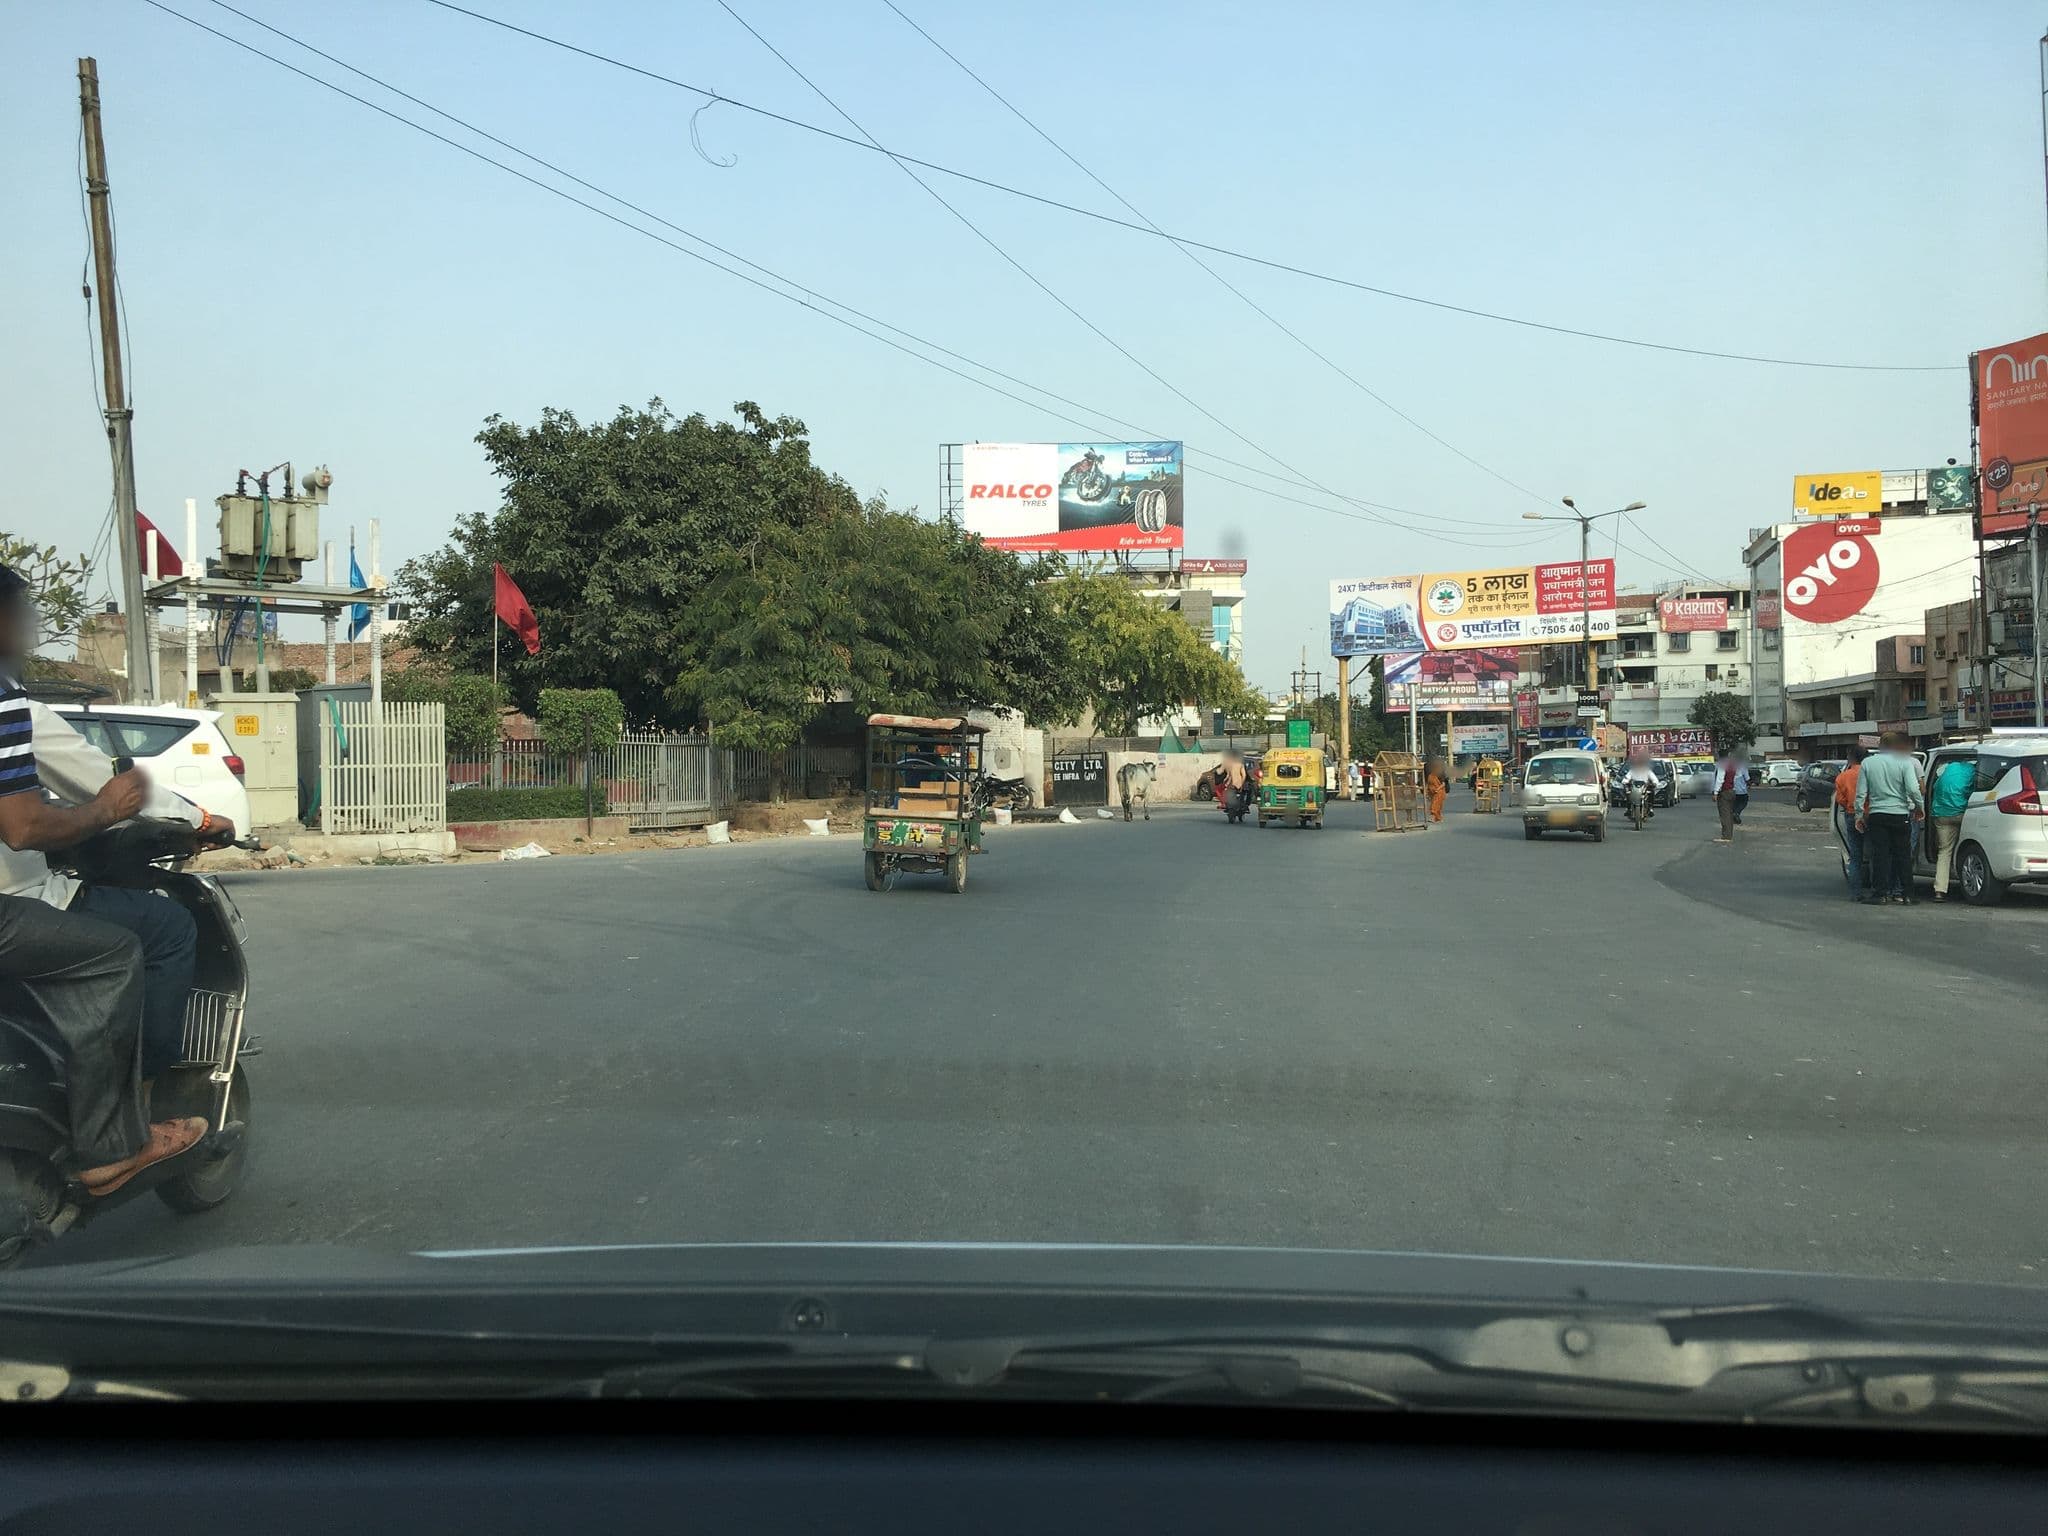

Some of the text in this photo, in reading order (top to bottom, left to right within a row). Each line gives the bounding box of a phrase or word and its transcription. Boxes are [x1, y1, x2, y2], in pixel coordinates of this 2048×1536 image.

[1986, 384, 2031, 400] SANITARY
[969, 483, 1053, 499] RALCO
[1838, 524, 1861, 533] OYO
[1137, 537, 1152, 545] with
[1787, 540, 1861, 605] OYO
[1467, 578, 1477, 592] 5
[1483, 573, 1529, 591] लाख
[1337, 584, 1356, 593] 24X7
[1468, 594, 1484, 603] तक
[1486, 594, 1499, 602] का
[1675, 600, 1725, 615] KARIM'S
[1541, 625, 1566, 634] 7505
[1590, 622, 1610, 631] 400
[1451, 686, 1477, 694] PROUD
[1631, 733, 1666, 744] HILL'S
[1054, 760, 1103, 771] CITY LTD.
[1062, 773, 1080, 781] INFRA
